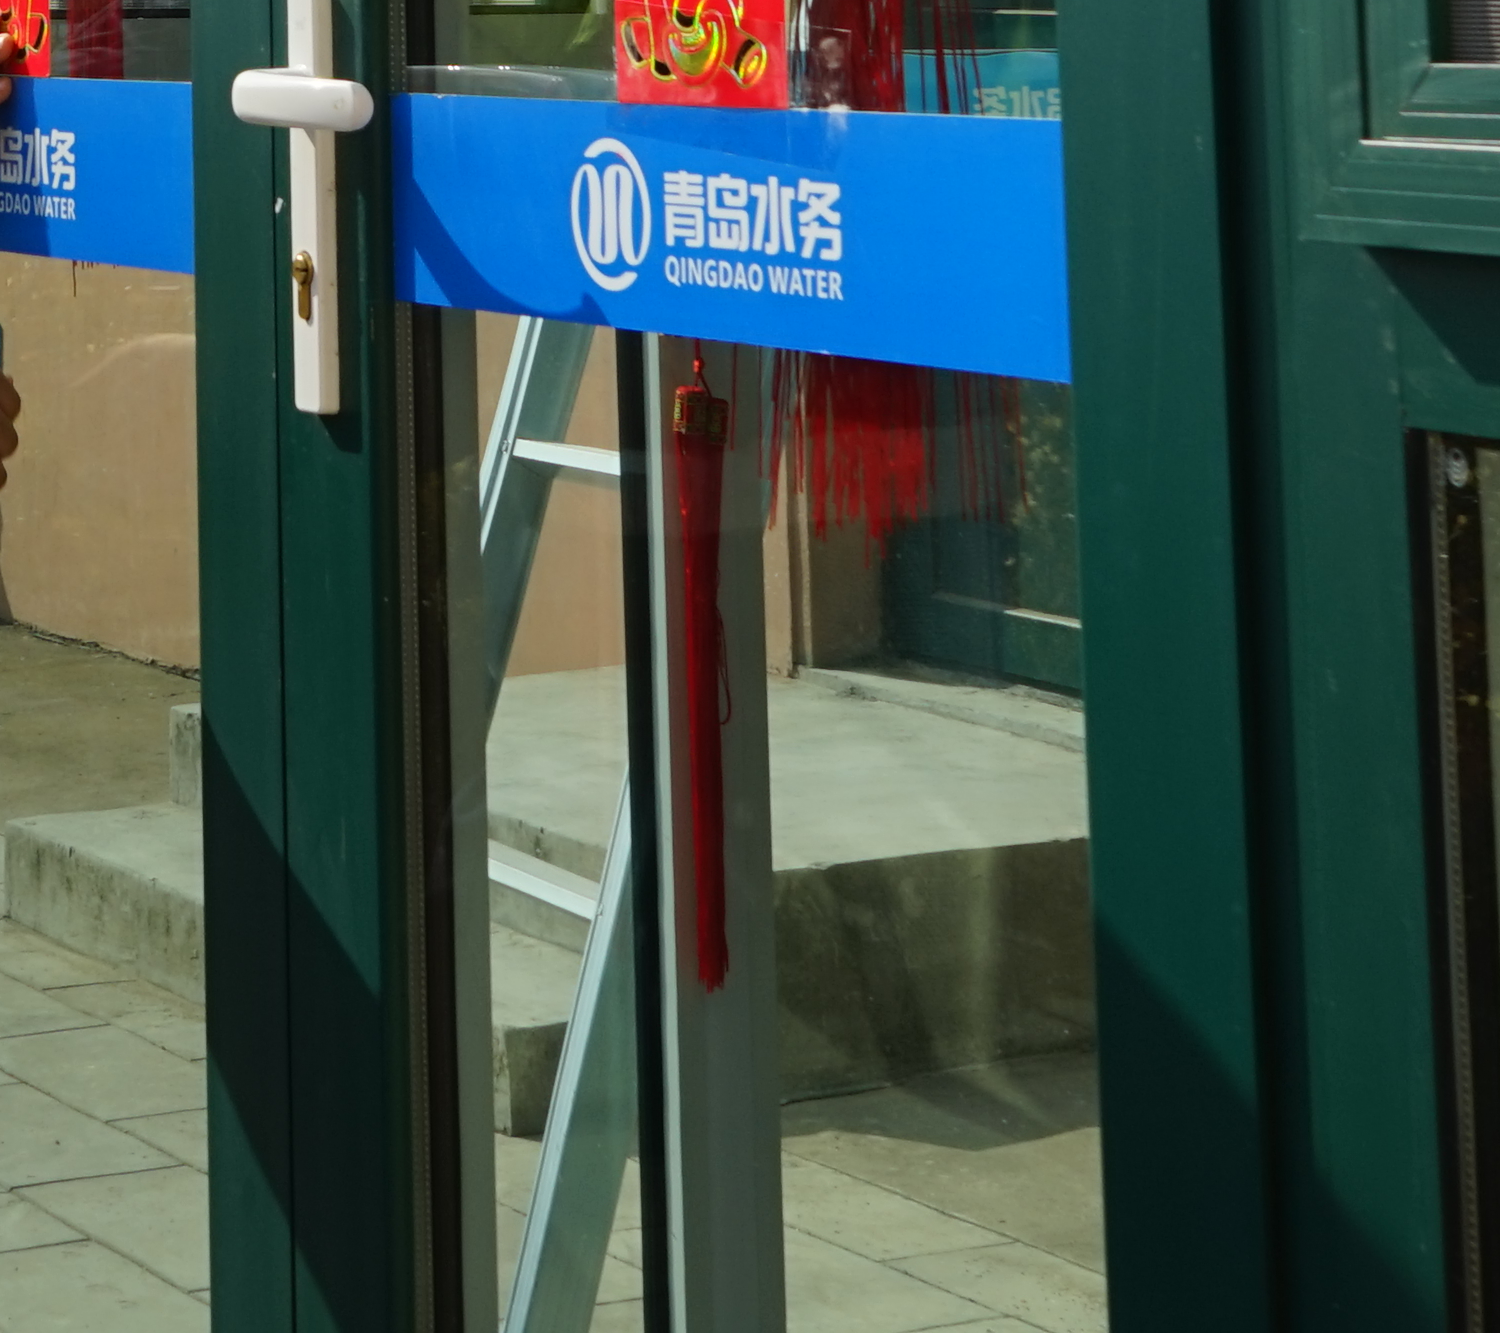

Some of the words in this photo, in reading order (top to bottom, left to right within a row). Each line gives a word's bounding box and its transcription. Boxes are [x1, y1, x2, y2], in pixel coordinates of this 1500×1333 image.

[33, 195, 76, 221] WATER
[663, 170, 843, 262] 青岛水务
[664, 255, 764, 292] QINGDAO
[767, 265, 844, 301] WATER
